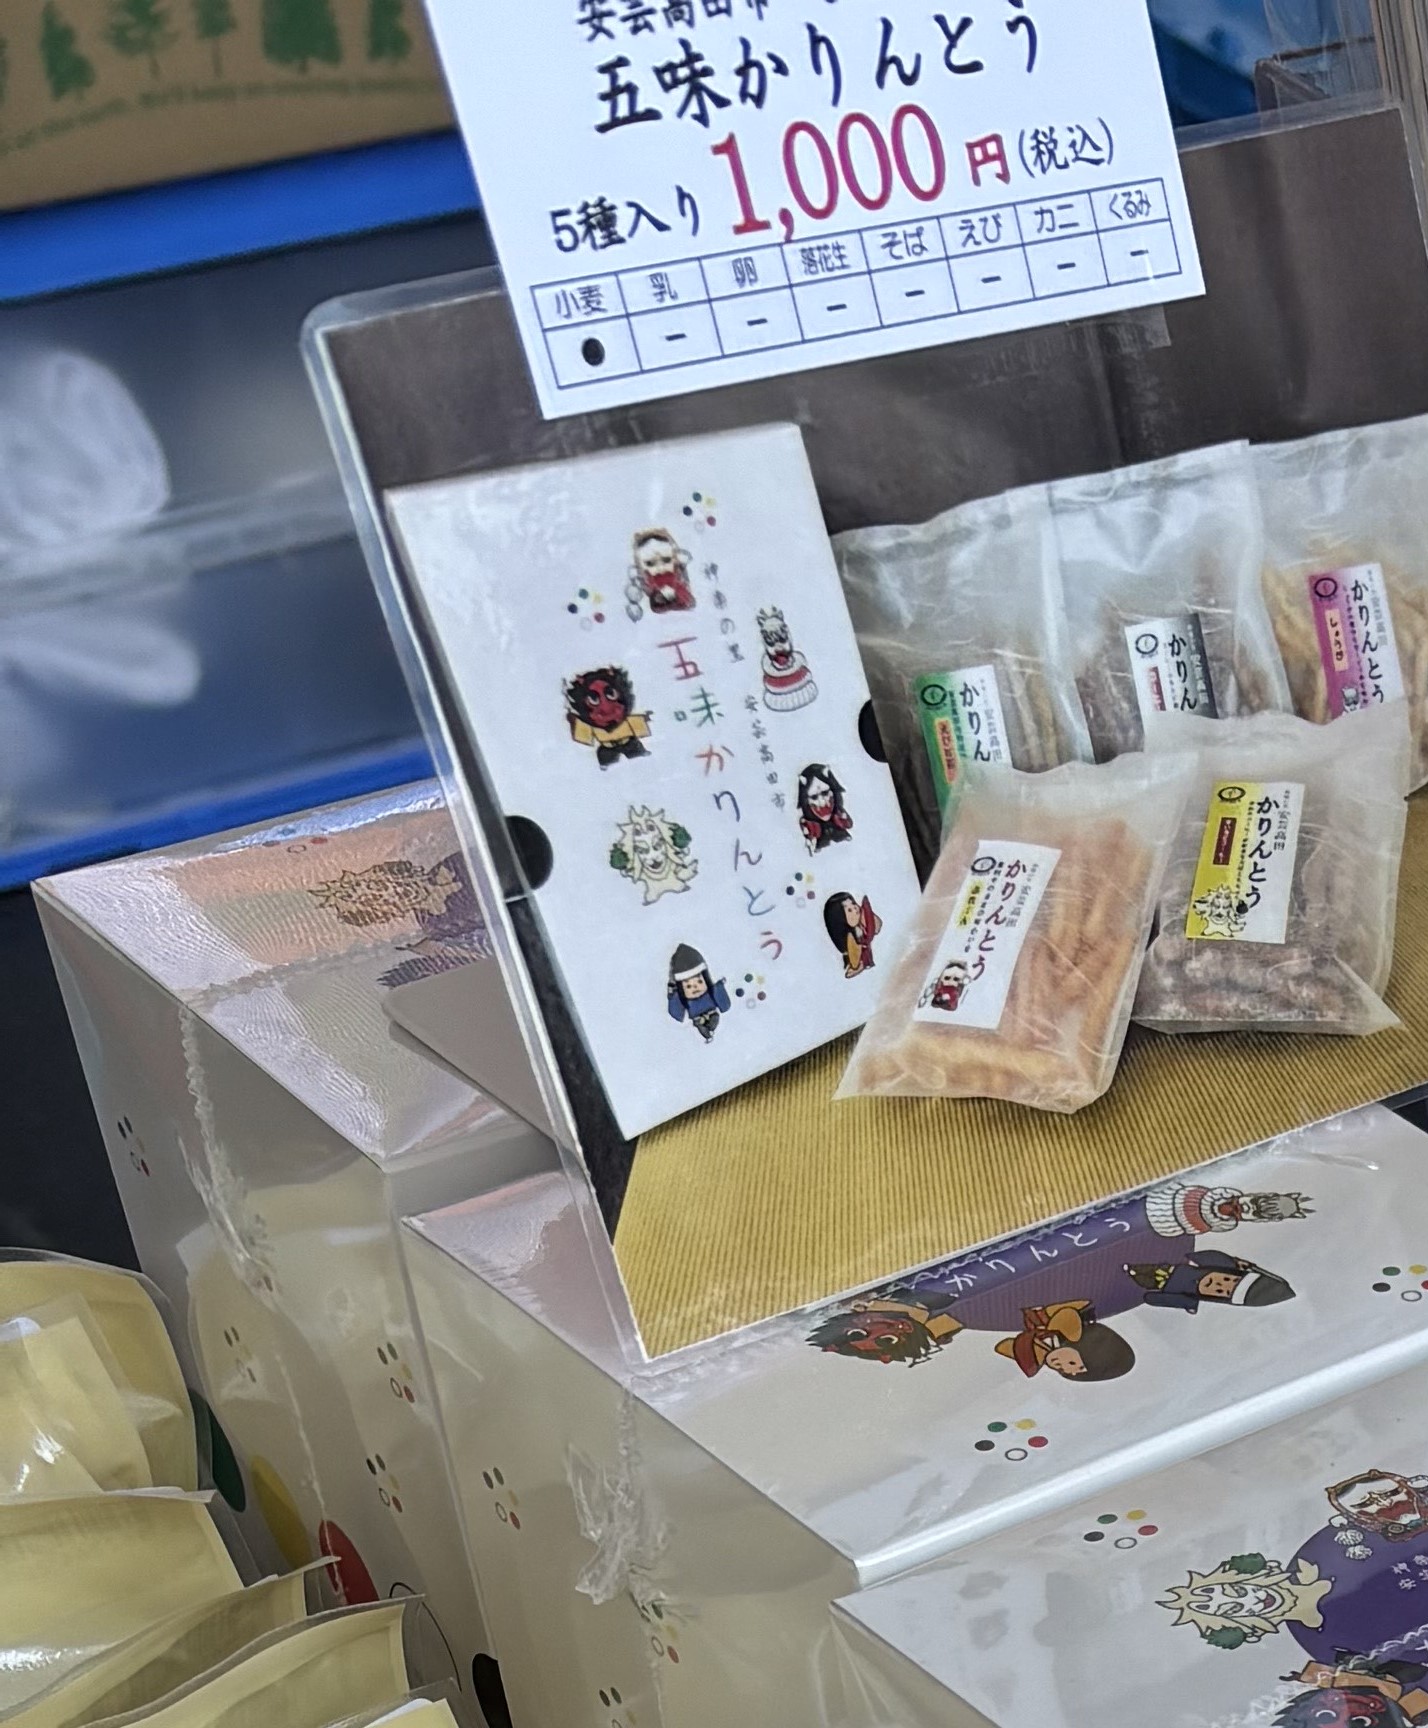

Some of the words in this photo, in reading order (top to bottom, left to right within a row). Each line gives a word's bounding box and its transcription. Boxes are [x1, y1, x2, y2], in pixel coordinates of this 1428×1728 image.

[593, 0, 1039, 134] 五味かりんとう
[549, 185, 701, 255] 5種入り
[881, 226, 930, 261] そば
[958, 214, 1005, 251] えび
[1035, 203, 1077, 236] カニ
[1350, 578, 1386, 705] かりんとう
[657, 632, 785, 962] 五味かりんとう
[1245, 795, 1280, 909] かりんとう
[971, 858, 1029, 983] かりんとう
